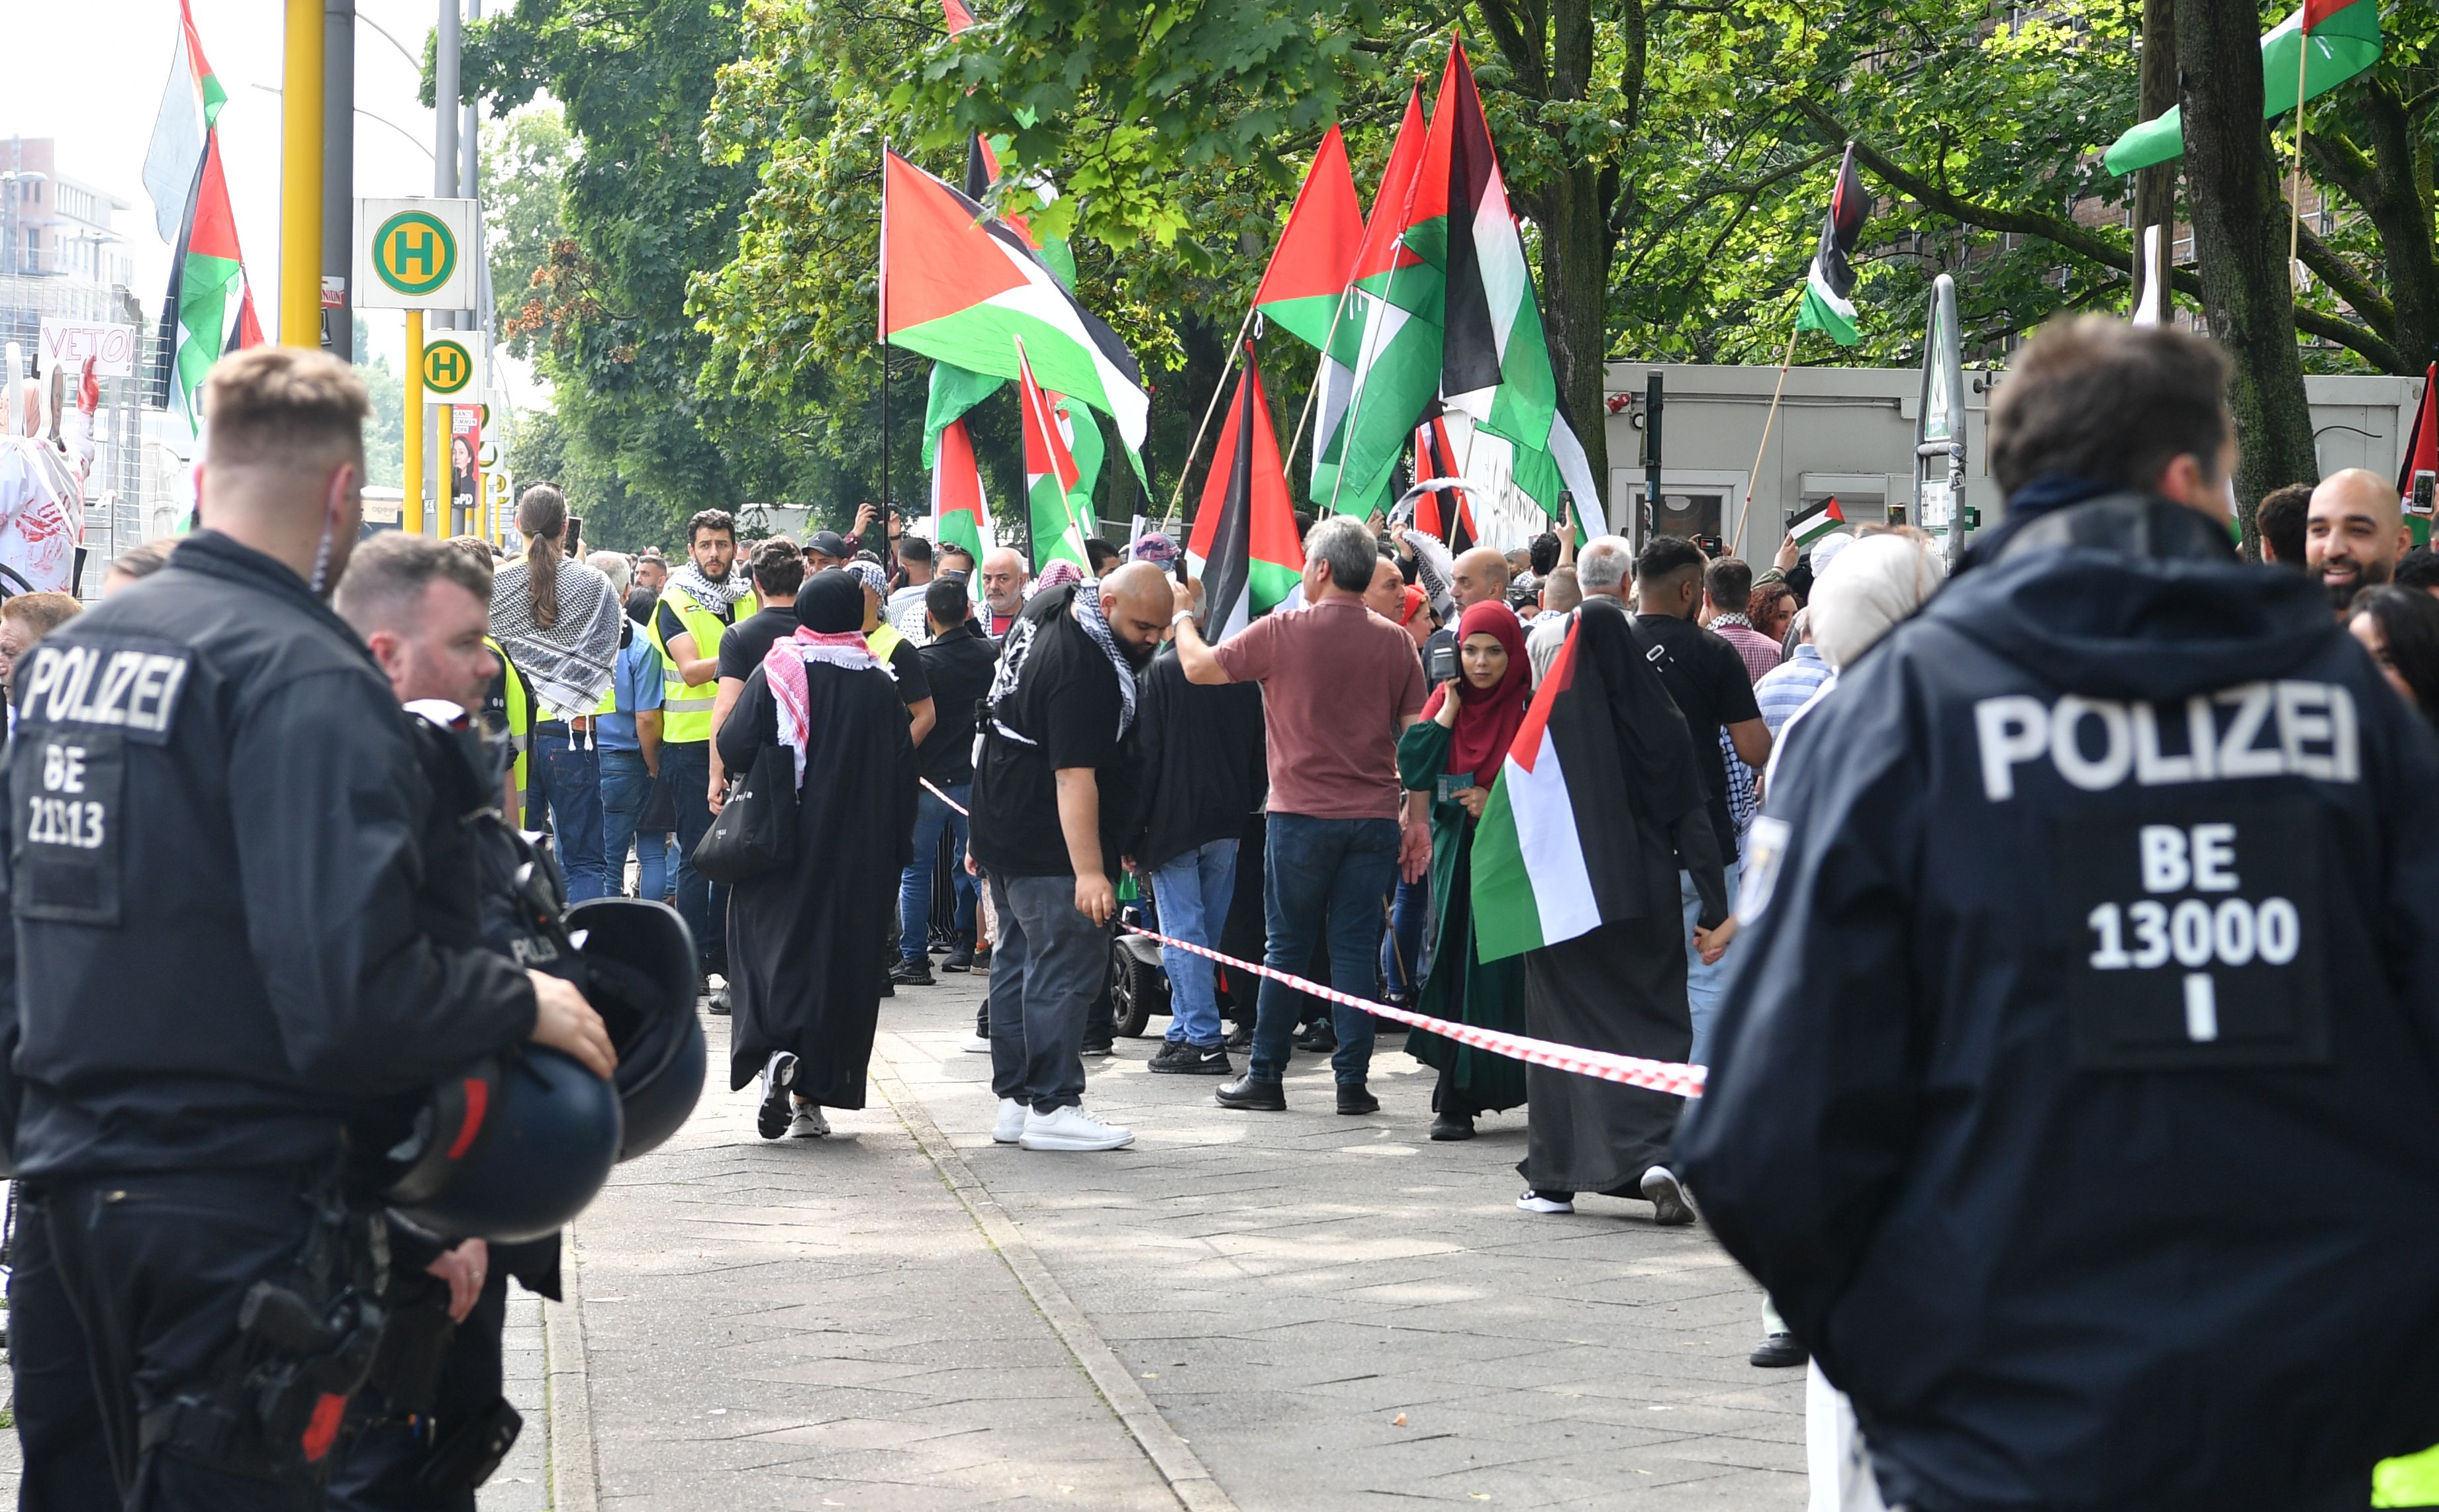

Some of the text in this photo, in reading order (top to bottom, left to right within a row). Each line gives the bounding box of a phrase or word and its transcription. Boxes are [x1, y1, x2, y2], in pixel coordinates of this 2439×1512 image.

[395, 231, 433, 276] H
[42, 327, 134, 371] VETO!
[432, 353, 457, 382] H
[20, 645, 187, 732] POLIZEI
[43, 743, 87, 793] BE
[1974, 679, 2361, 802] POLIZEI
[2139, 823, 2240, 894] BE
[2087, 896, 2301, 970] 13000
[2183, 972, 2219, 1043] I
